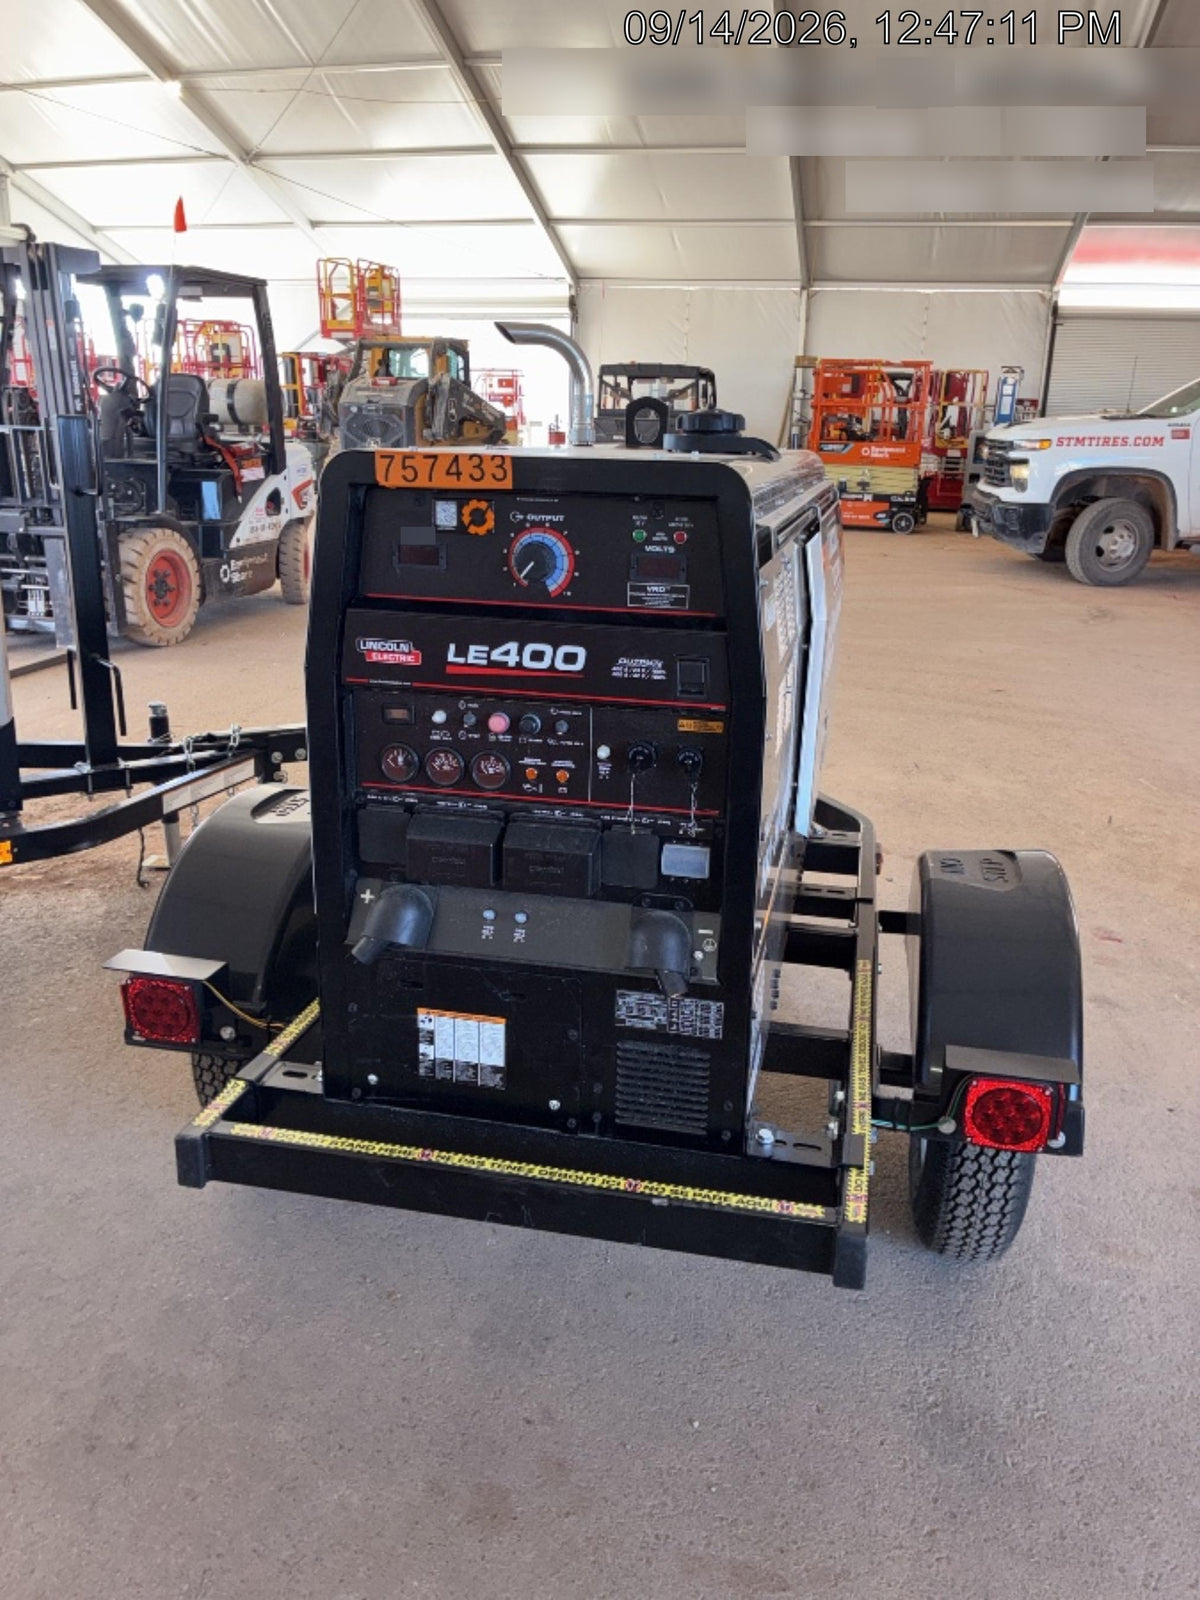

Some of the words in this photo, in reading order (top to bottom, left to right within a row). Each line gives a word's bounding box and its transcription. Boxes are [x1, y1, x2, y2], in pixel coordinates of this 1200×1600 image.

[1056, 436, 1165, 447] STMTIRES.COM
[379, 454, 510, 484] 757433
[526, 513, 566, 522] OUTPUT
[360, 639, 410, 653] LINCOLN
[371, 652, 416, 662] ELECTRIC
[446, 640, 587, 672] LE400
[276, 1131, 296, 1141] DO
[299, 1134, 326, 1145] NOT
[329, 1139, 376, 1151] STAND
[378, 1146, 416, 1157] HERE
[458, 1157, 486, 1167] PAS
[643, 1185, 666, 1194] NO
